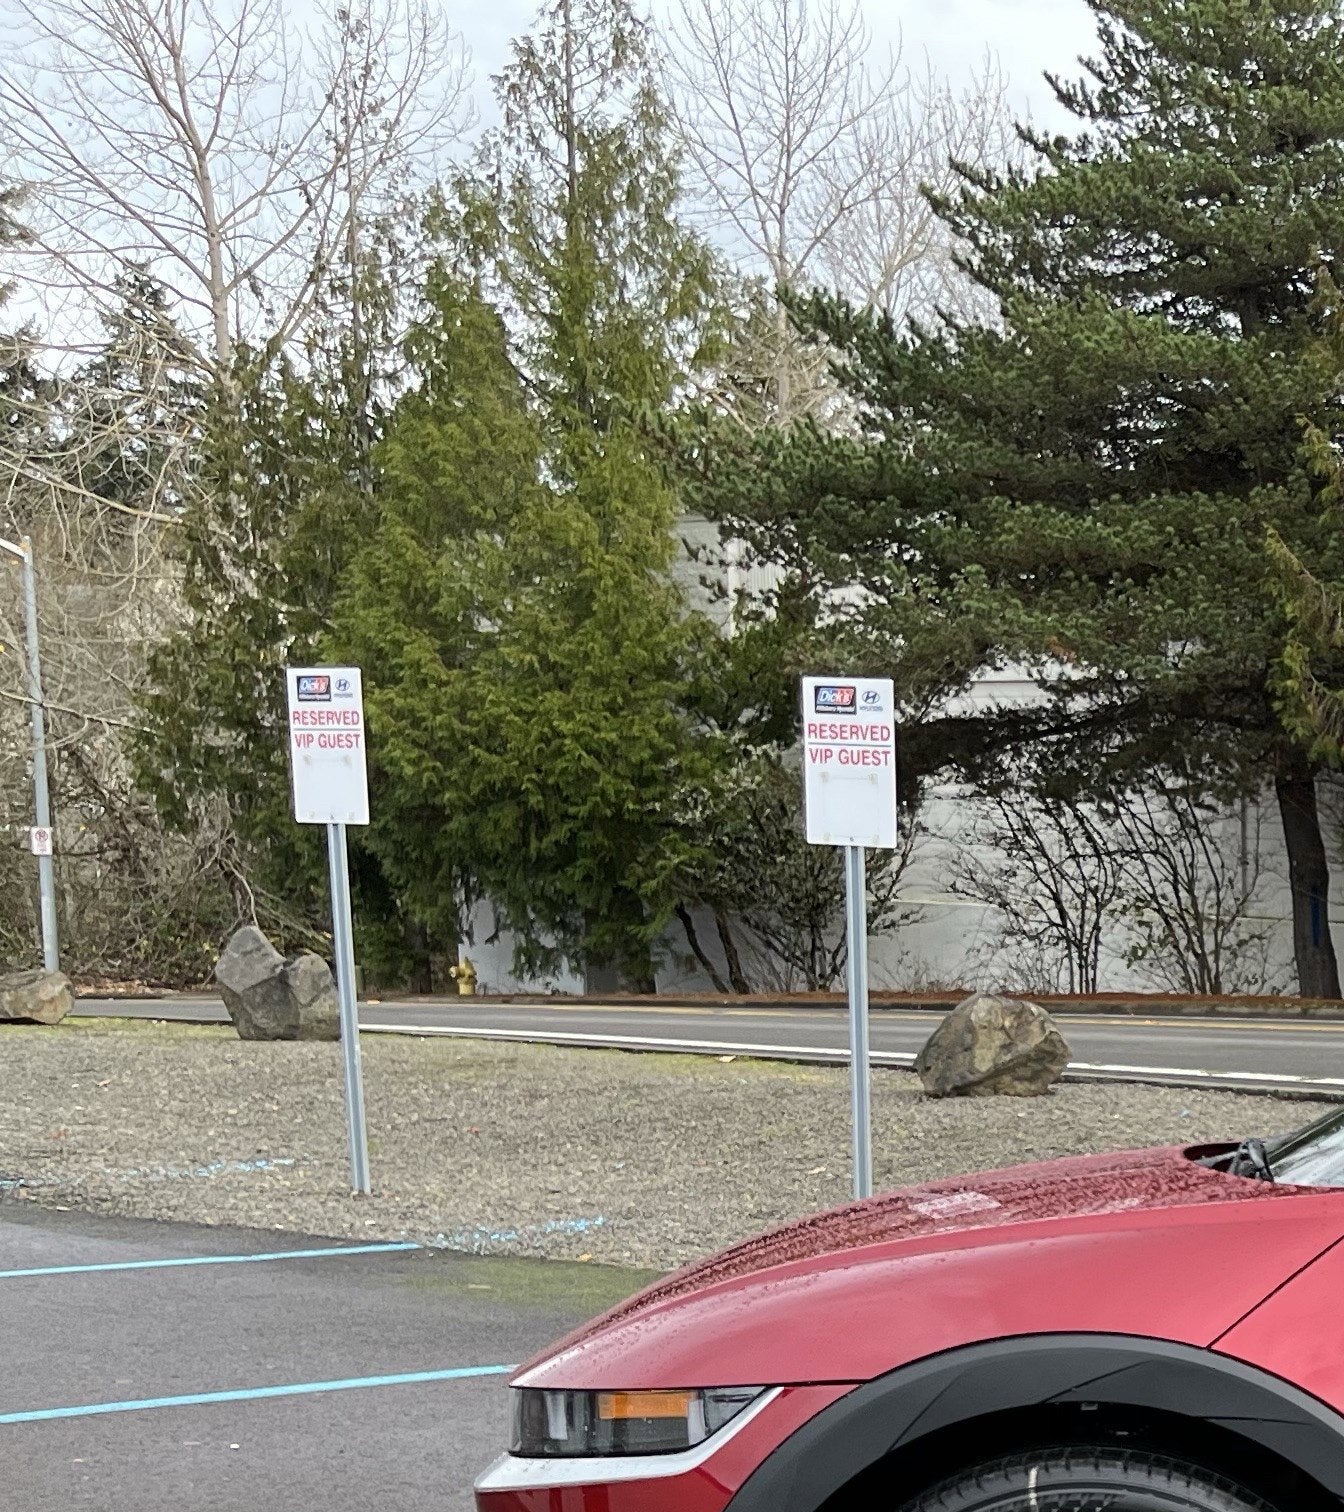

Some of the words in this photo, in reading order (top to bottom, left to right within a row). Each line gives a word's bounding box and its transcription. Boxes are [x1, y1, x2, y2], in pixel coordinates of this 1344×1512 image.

[292, 710, 361, 726] RESERVED
[294, 733, 314, 748] VIP
[317, 733, 361, 749] GUEST
[807, 723, 891, 742] RESERVED
[809, 748, 833, 764] VIP
[838, 749, 891, 766] GUEST
